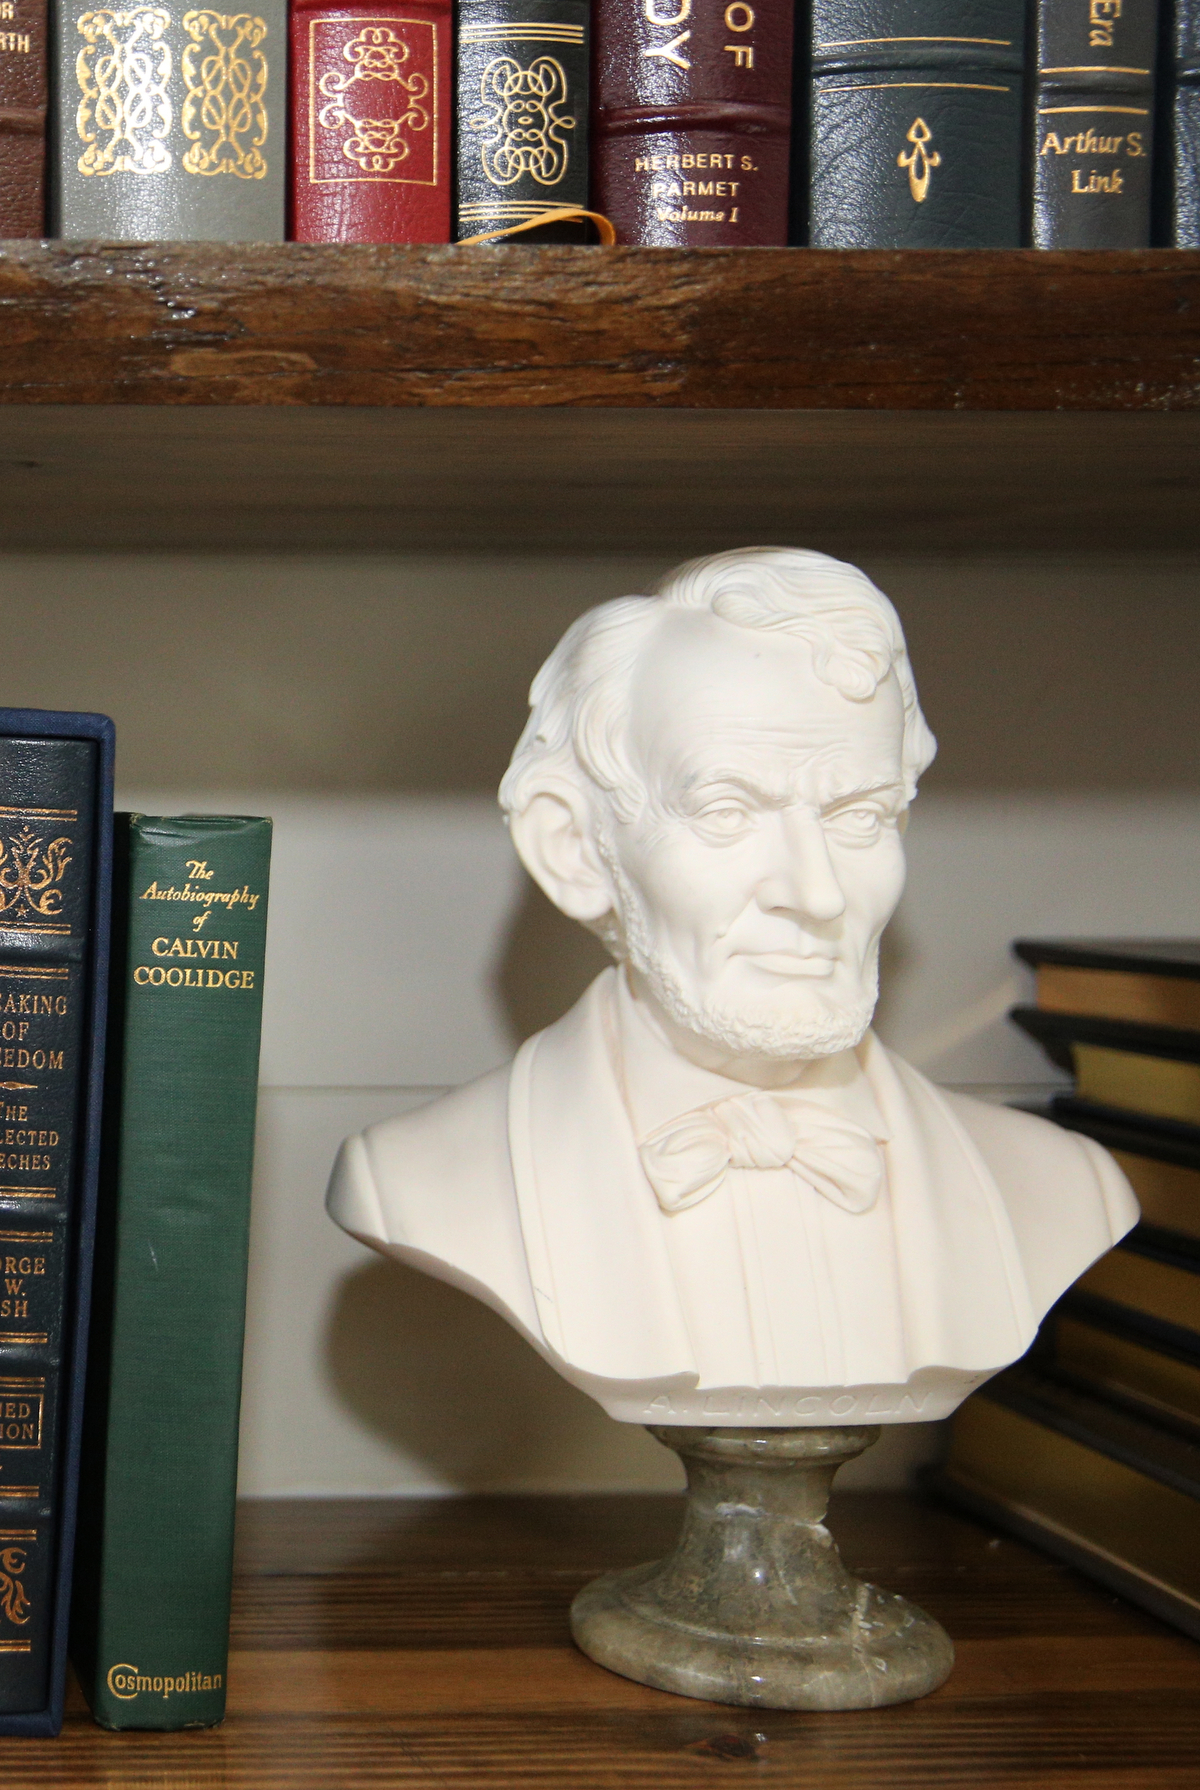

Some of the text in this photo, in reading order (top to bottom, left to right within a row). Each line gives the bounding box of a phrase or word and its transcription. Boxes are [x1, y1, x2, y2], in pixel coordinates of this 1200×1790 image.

[723, 1, 755, 69] OF
[1089, 0, 1122, 47] Era
[1039, 128, 1123, 156] Arthur
[635, 153, 759, 172] HERBERT S.
[652, 180, 741, 198] PARMET
[1070, 168, 1124, 194] Link
[654, 204, 724, 223] Volume
[185, 859, 215, 881] The
[138, 881, 261, 911] Autobiography
[192, 911, 212, 932] of
[151, 937, 240, 960] CALVIN
[133, 965, 255, 989] COOLIDGE
[1, 1021, 30, 1042] OF
[3, 1278, 27, 1297] W.
[701, 1391, 936, 1418] LINCOLN
[106, 1663, 223, 1699] Cosmopolitan
